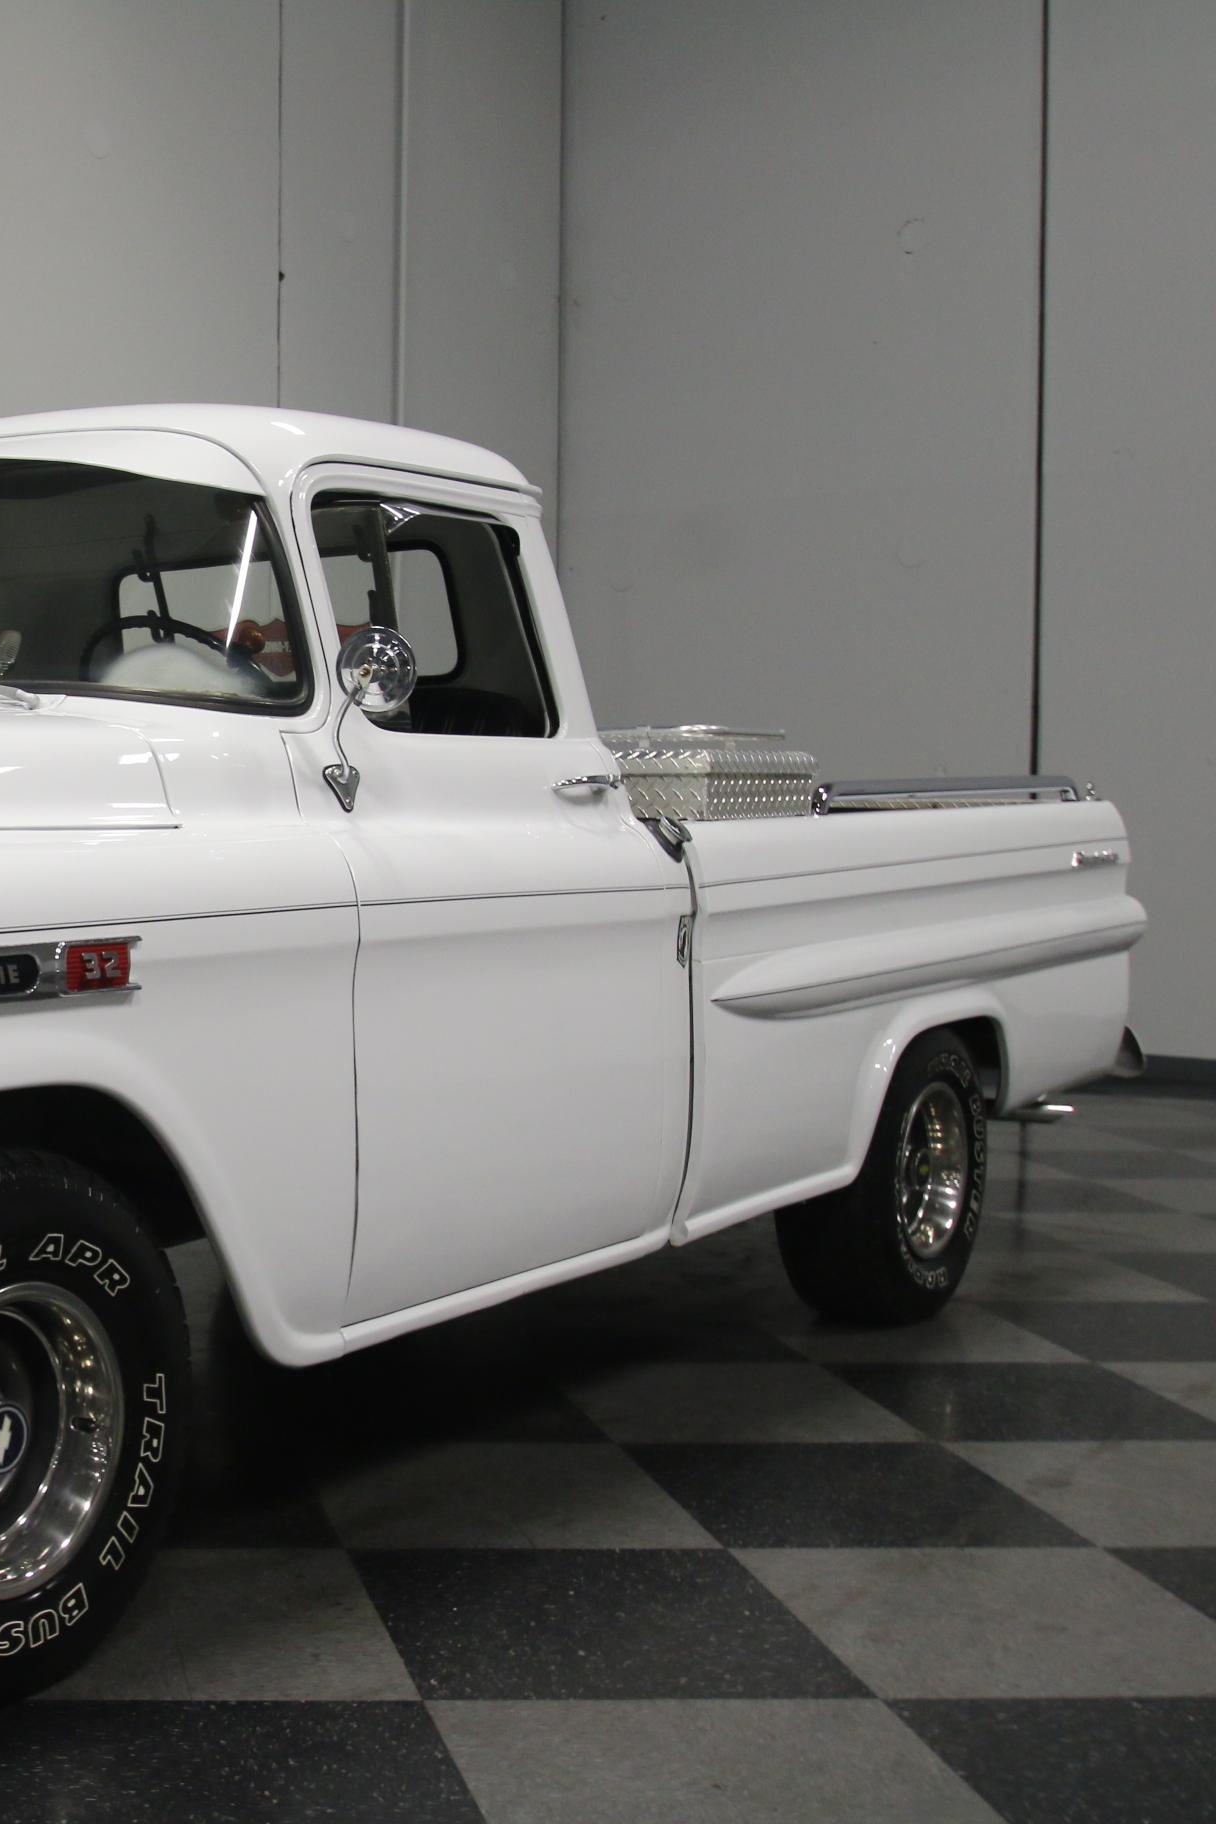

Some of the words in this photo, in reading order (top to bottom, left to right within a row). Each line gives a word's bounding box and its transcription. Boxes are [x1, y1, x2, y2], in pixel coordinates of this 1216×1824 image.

[81, 950, 122, 981] 32
[29, 1233, 131, 1297] APR
[98, 1373, 167, 1571] TRAIL
